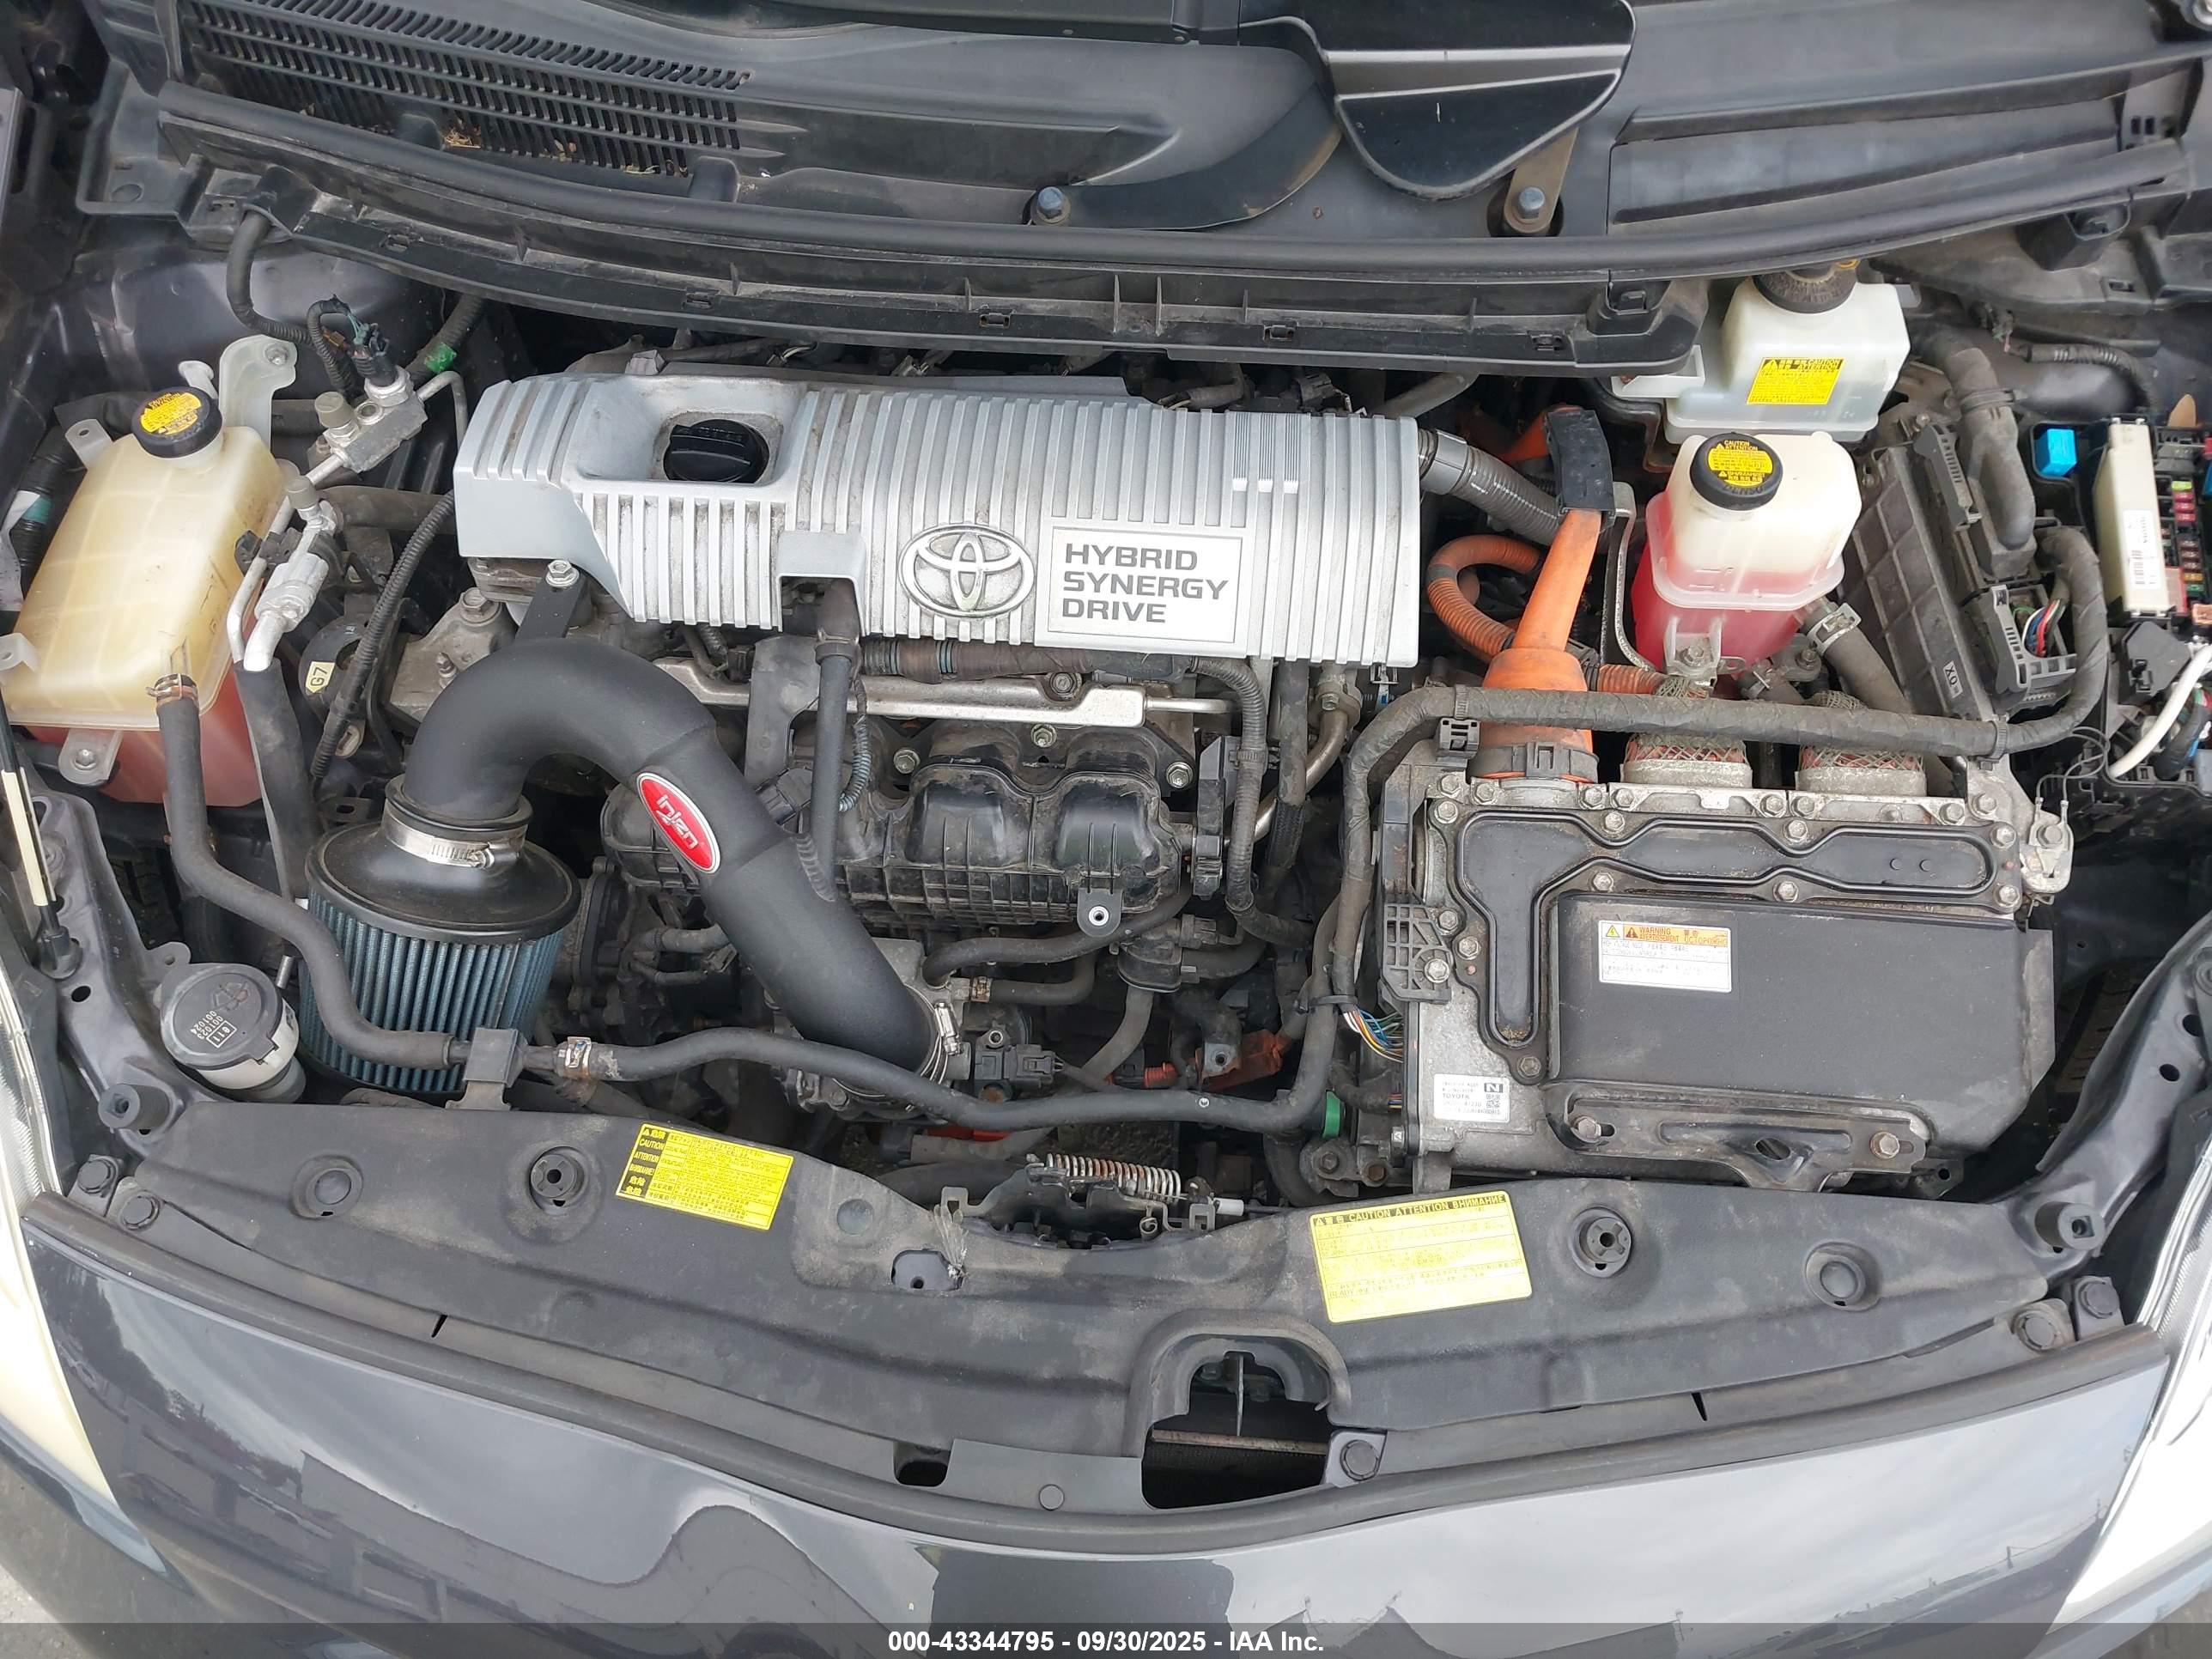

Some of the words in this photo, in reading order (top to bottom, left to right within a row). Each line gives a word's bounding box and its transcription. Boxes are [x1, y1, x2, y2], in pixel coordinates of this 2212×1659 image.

[1065, 543, 1198, 571] HYBRID
[1063, 571, 1229, 600] SYNERGY
[1061, 598, 1167, 623] DRIVE
[310, 666, 328, 686] G7
[1639, 927, 1671, 936] WARNING
[1486, 1083, 1500, 1093] N
[639, 1139, 665, 1151] CAUTION
[634, 1151, 660, 1164] ATTENTION
[1350, 1209, 1391, 1223] CAUTION
[1395, 1201, 1449, 1217] ATTENTION
[1452, 1194, 1504, 1210] ВНИМАНИЕ
